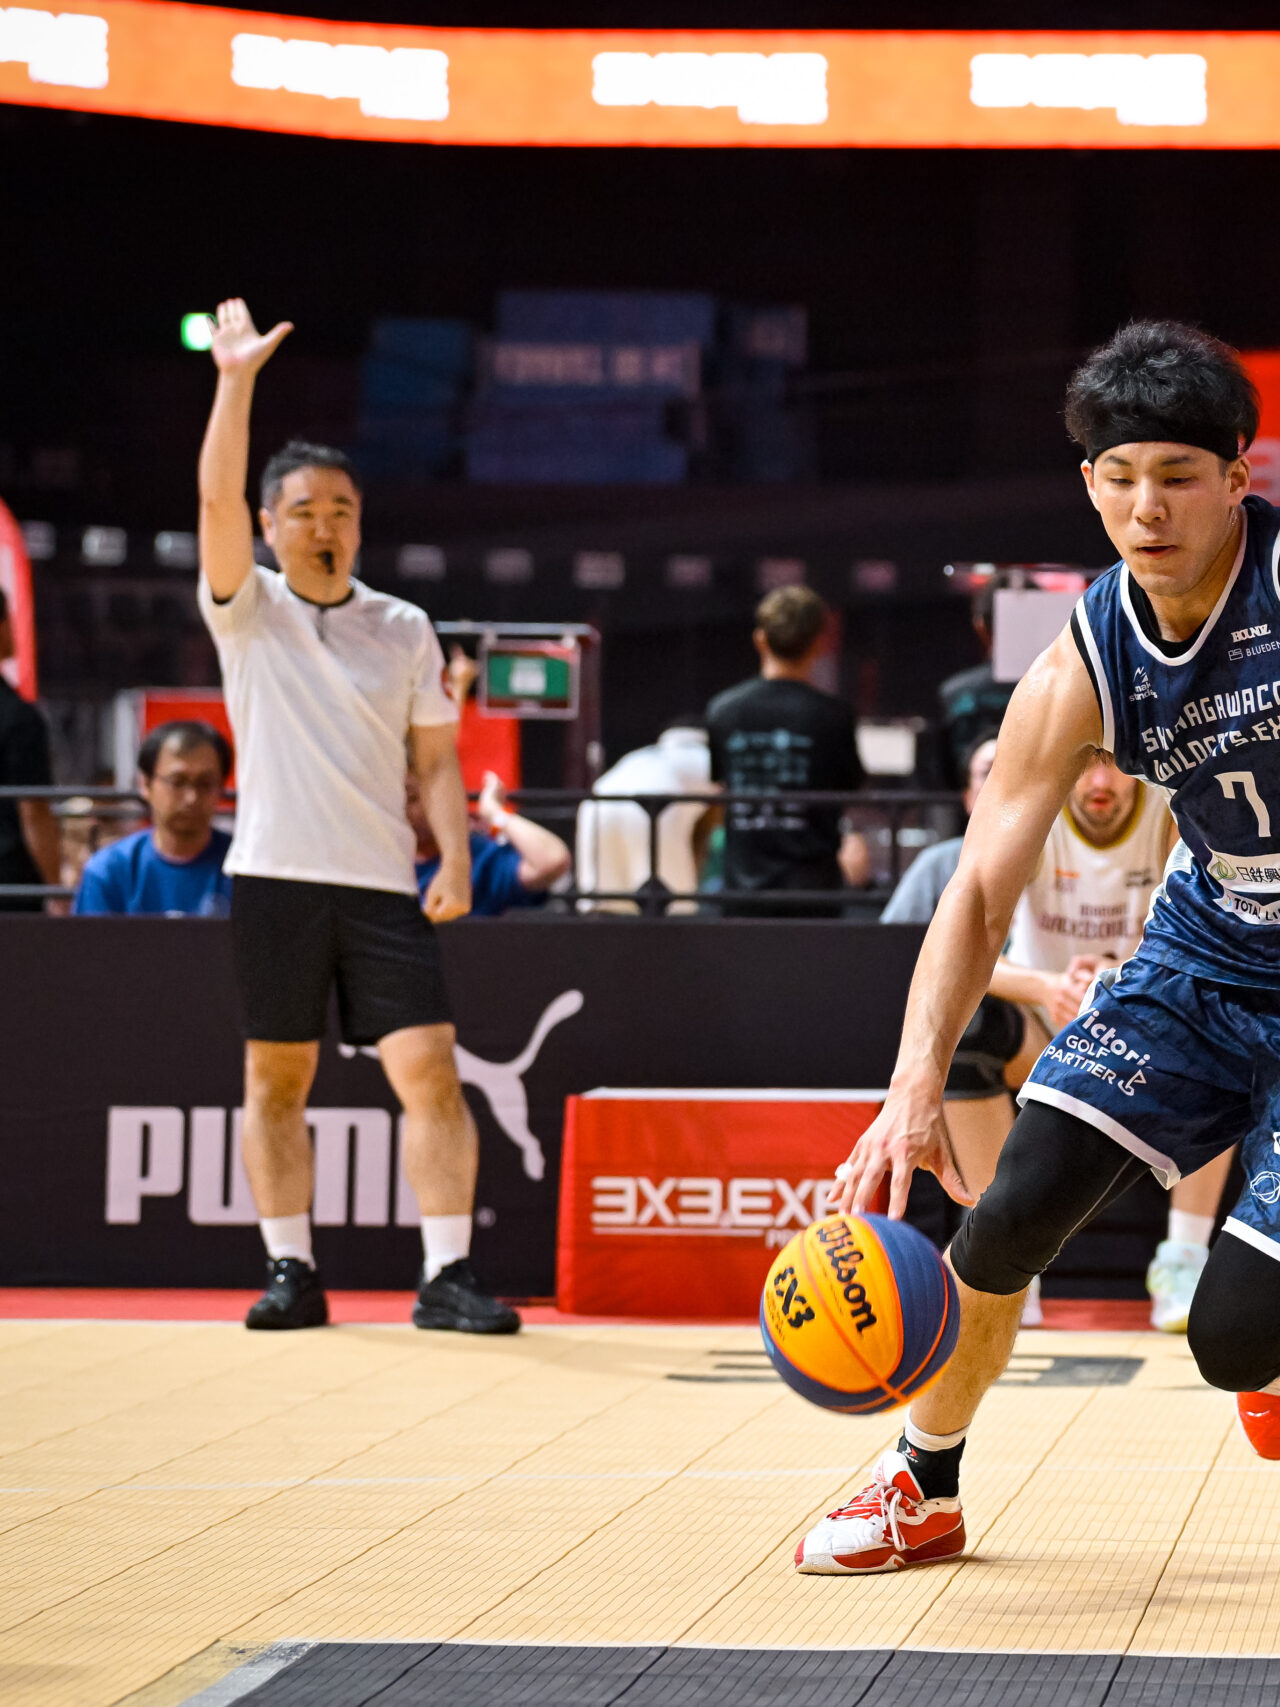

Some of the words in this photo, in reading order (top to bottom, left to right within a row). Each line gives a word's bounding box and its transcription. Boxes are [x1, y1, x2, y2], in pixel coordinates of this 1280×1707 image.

[1214, 771, 1271, 838] 7
[1234, 898, 1261, 920] TOTA
[1044, 1045, 1117, 1085] PARTNER
[1066, 1034, 1112, 1059] GOLF
[816, 1220, 877, 1333] Wilson
